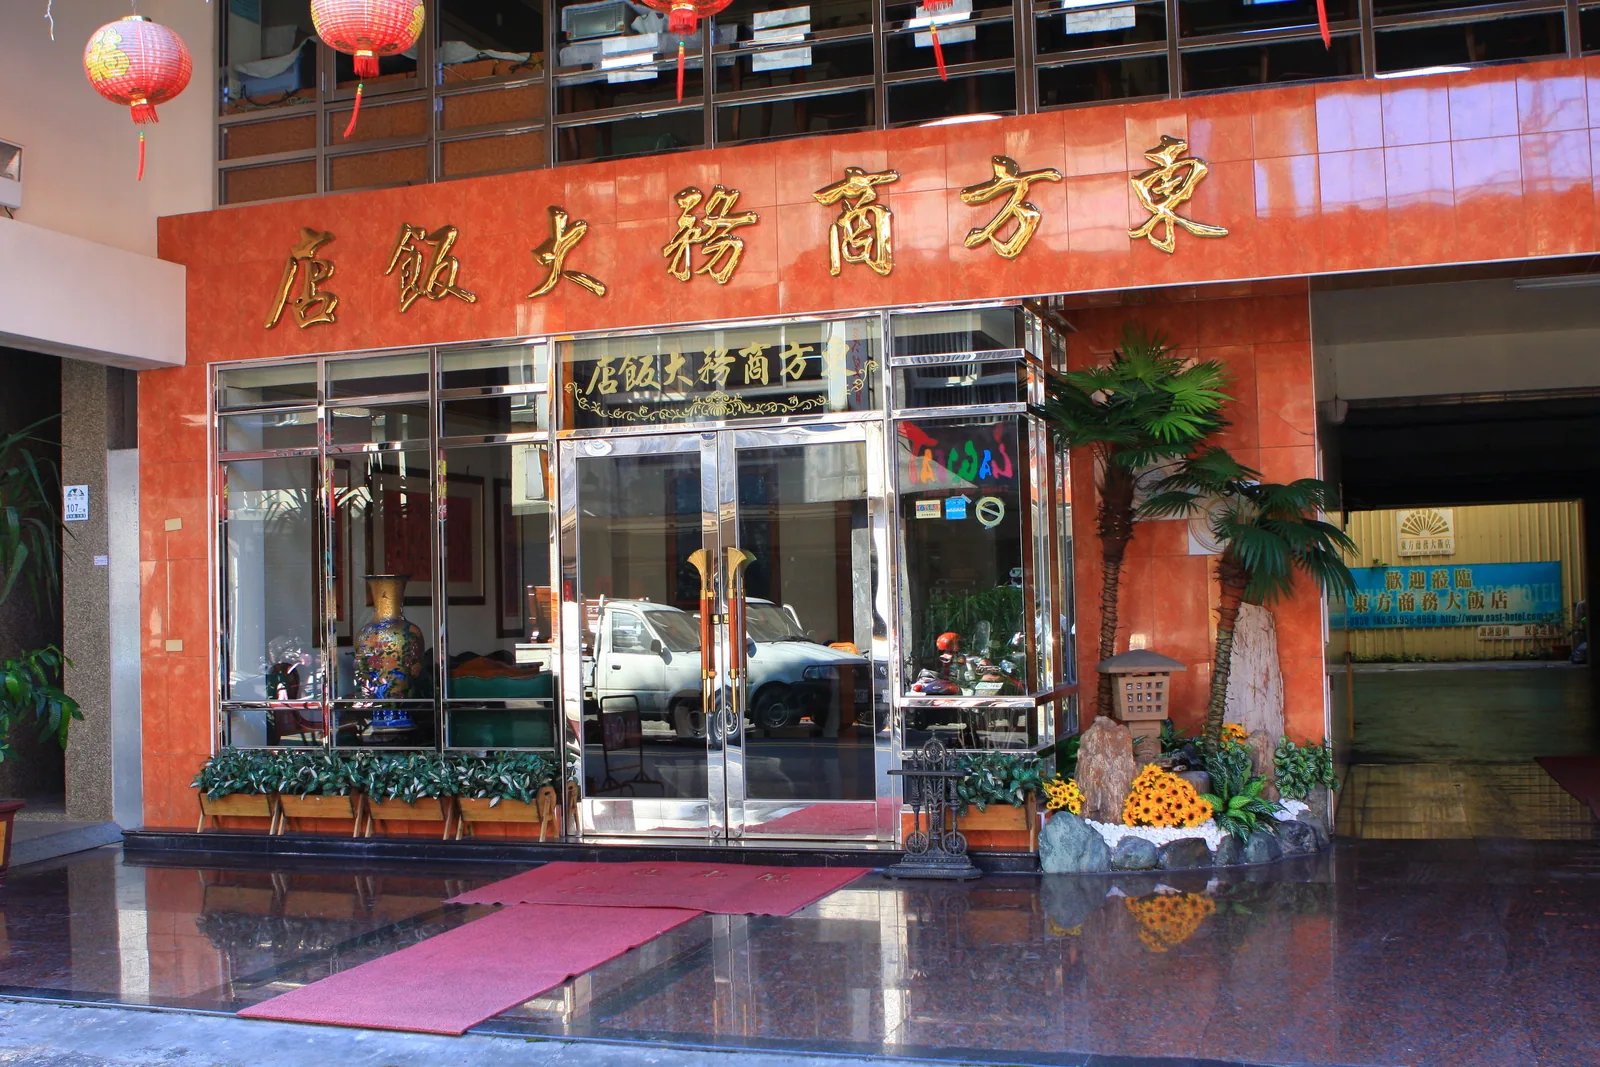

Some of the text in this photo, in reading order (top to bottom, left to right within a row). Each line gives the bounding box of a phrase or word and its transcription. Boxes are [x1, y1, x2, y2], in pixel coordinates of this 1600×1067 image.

[1353, 589, 1508, 614] 東方商務大飯店
